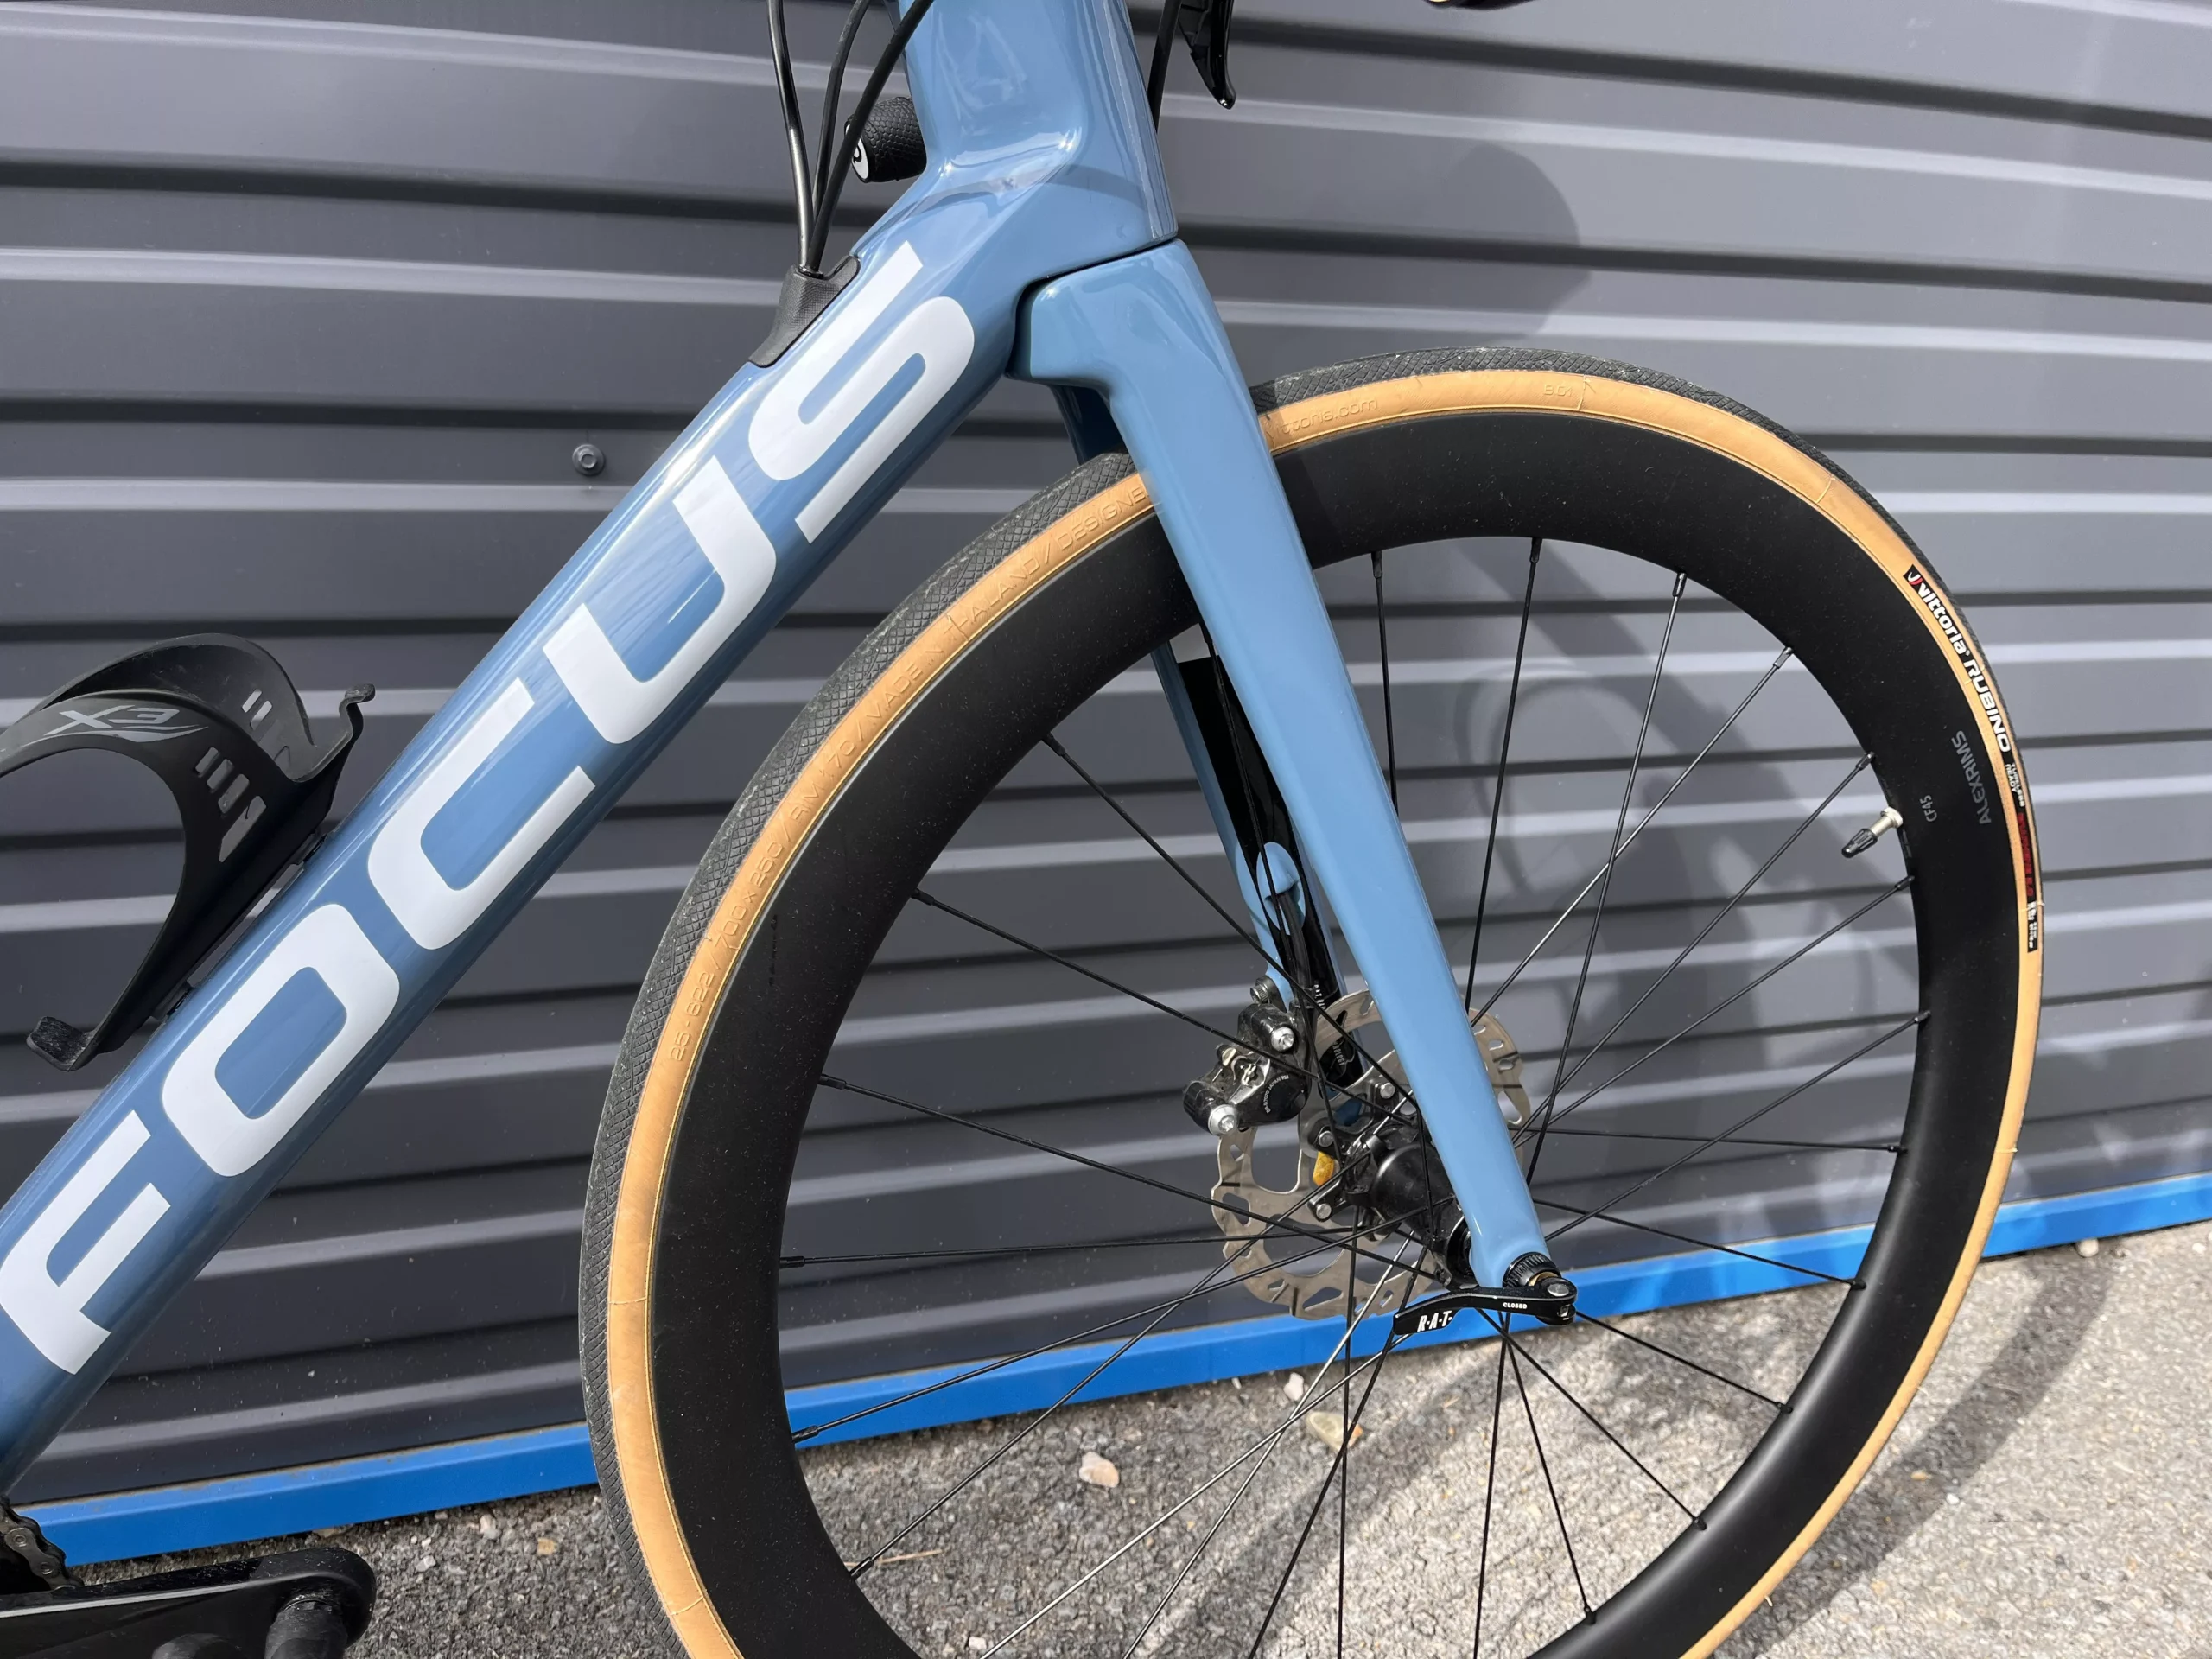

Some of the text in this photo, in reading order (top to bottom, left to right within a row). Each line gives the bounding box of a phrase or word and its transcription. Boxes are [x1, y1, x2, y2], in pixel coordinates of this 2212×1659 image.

[1056, 486, 1149, 551] DESIGNE
[43, 704, 180, 736] X3
[1963, 659, 2011, 753] RUBINO
[0, 240, 976, 1376] FOCUS
[1919, 794, 1938, 823] CF45
[1951, 730, 1992, 825] ALEXRIMS
